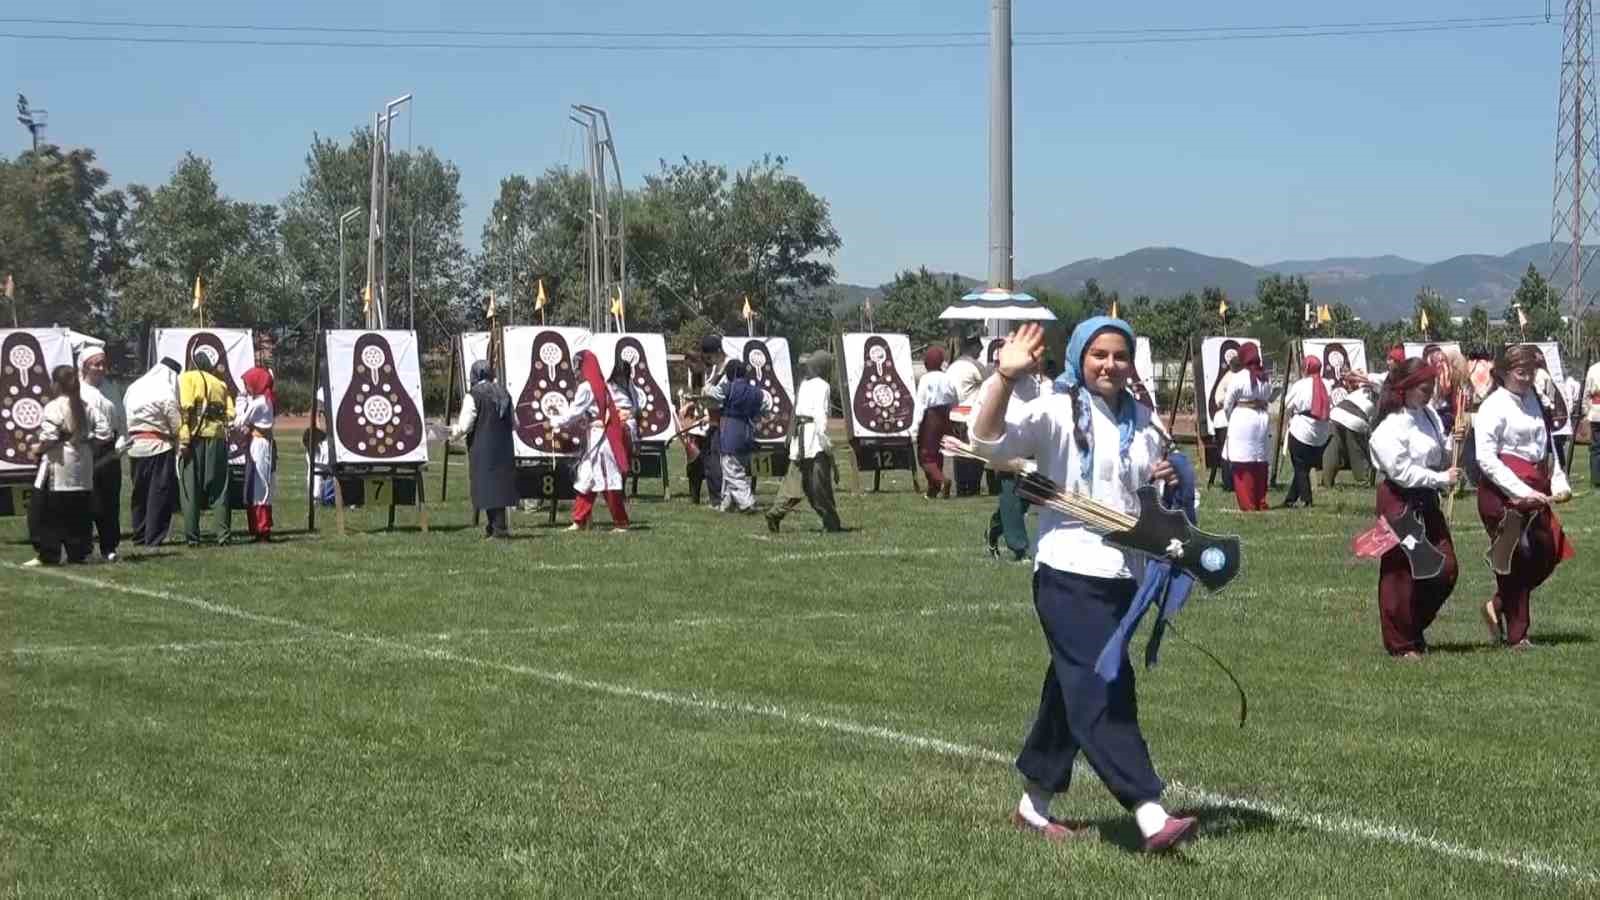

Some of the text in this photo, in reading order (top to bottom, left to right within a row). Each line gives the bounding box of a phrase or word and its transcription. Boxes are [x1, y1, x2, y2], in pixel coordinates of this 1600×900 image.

[874, 451, 894, 468] 12
[371, 480, 384, 500] 7
[543, 475, 554, 495] 8
